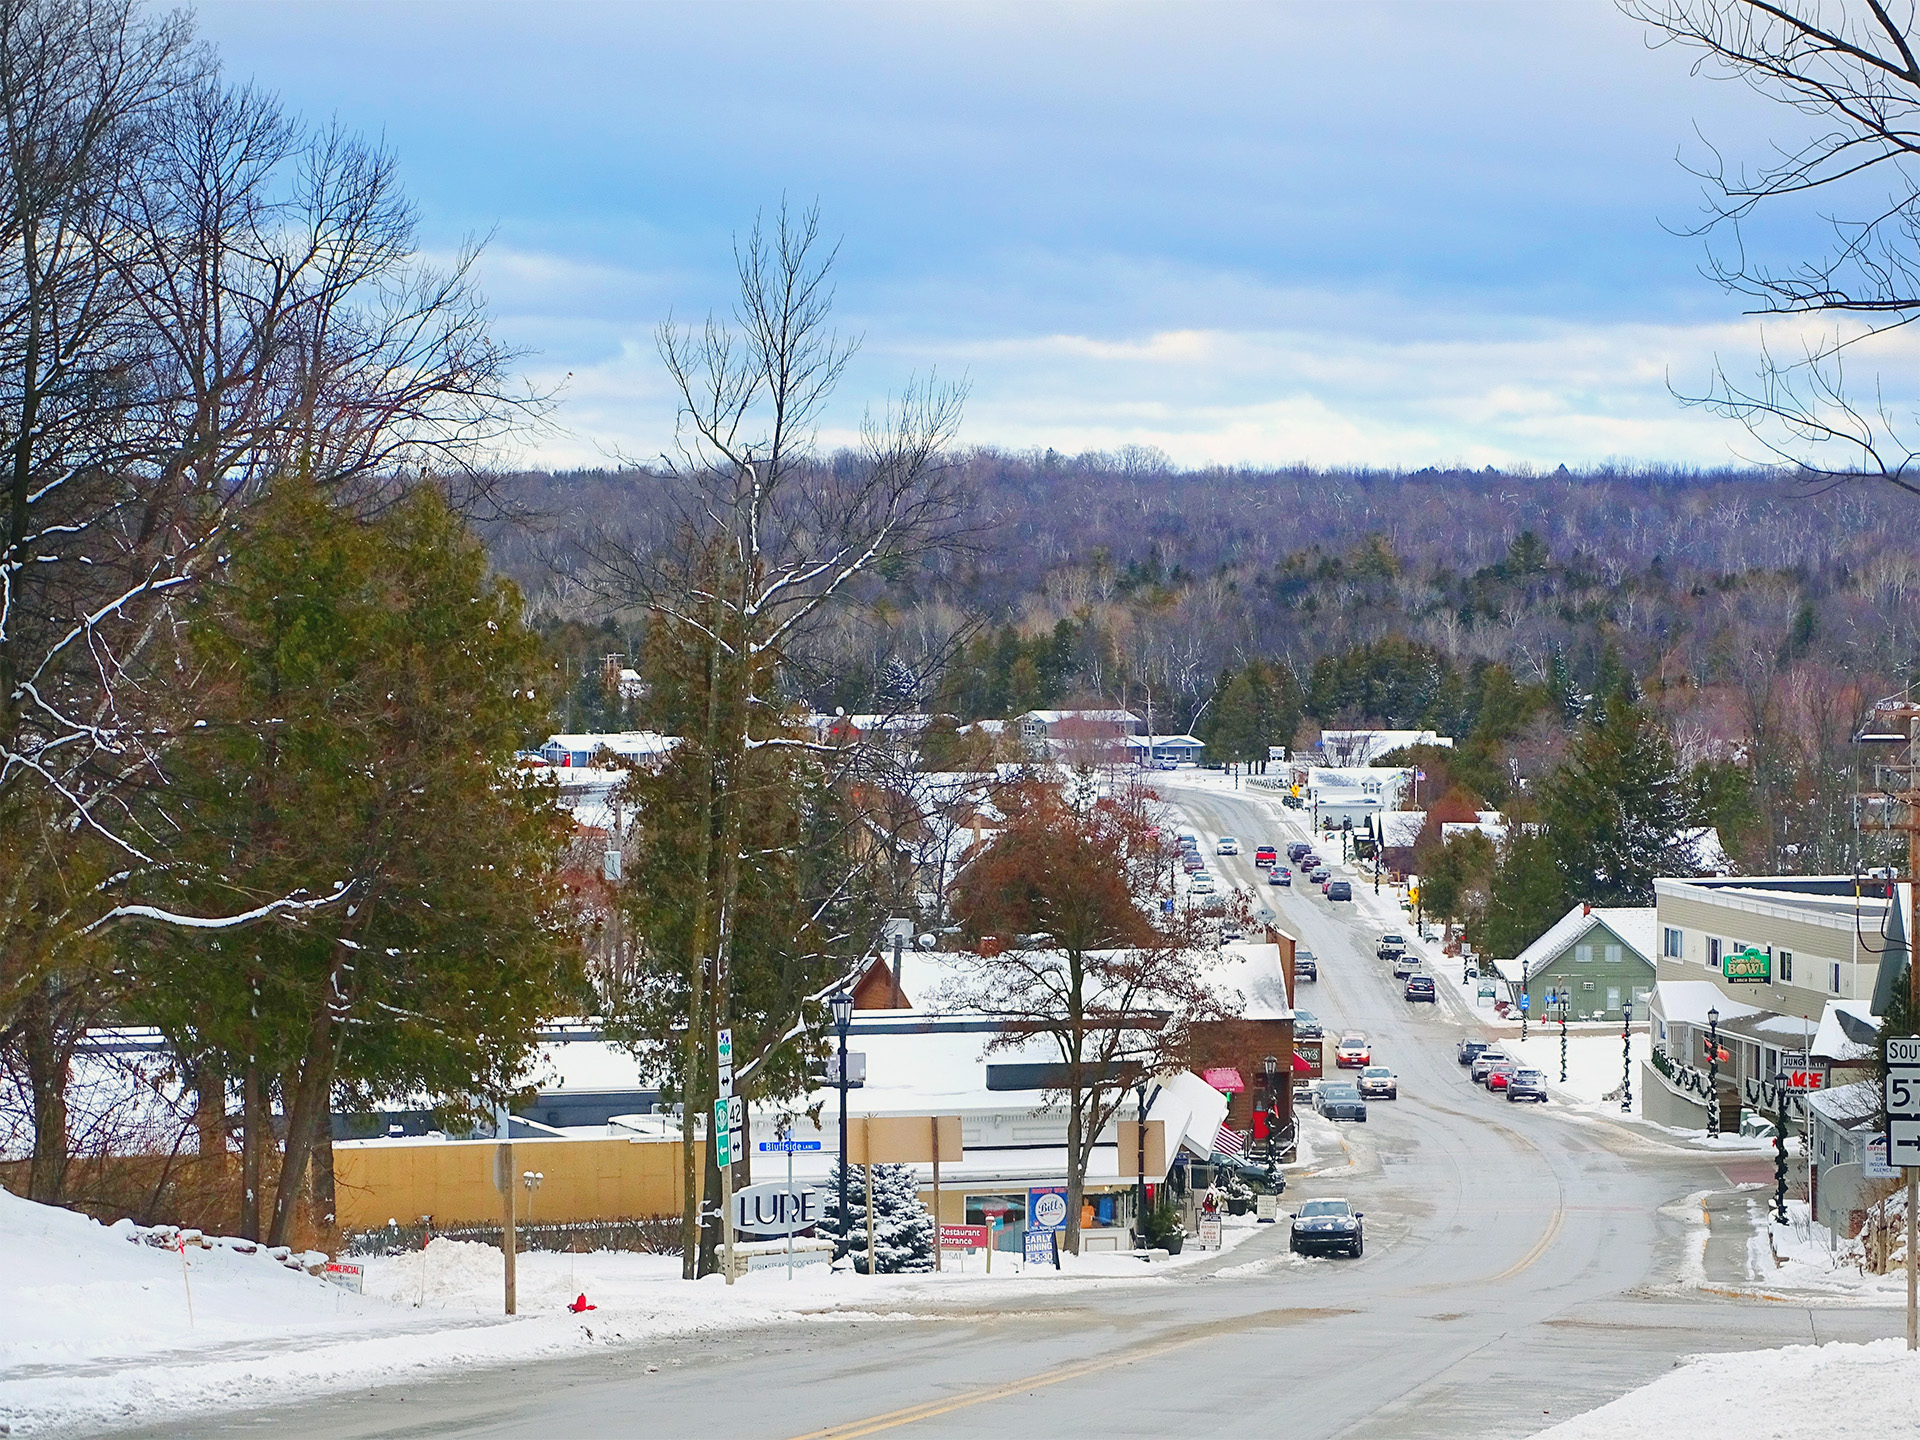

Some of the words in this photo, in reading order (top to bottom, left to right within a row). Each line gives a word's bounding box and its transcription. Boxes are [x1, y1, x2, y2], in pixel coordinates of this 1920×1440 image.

[1728, 963, 1766, 975] BOWL
[729, 1103, 741, 1123] 42
[765, 1142, 802, 1151] Bluffside
[740, 1192, 815, 1226] LURE
[940, 1227, 981, 1237] Restaurant
[940, 1236, 973, 1245] Entrance
[1025, 1234, 1053, 1244] EARLY
[1025, 1243, 1053, 1252] DINING
